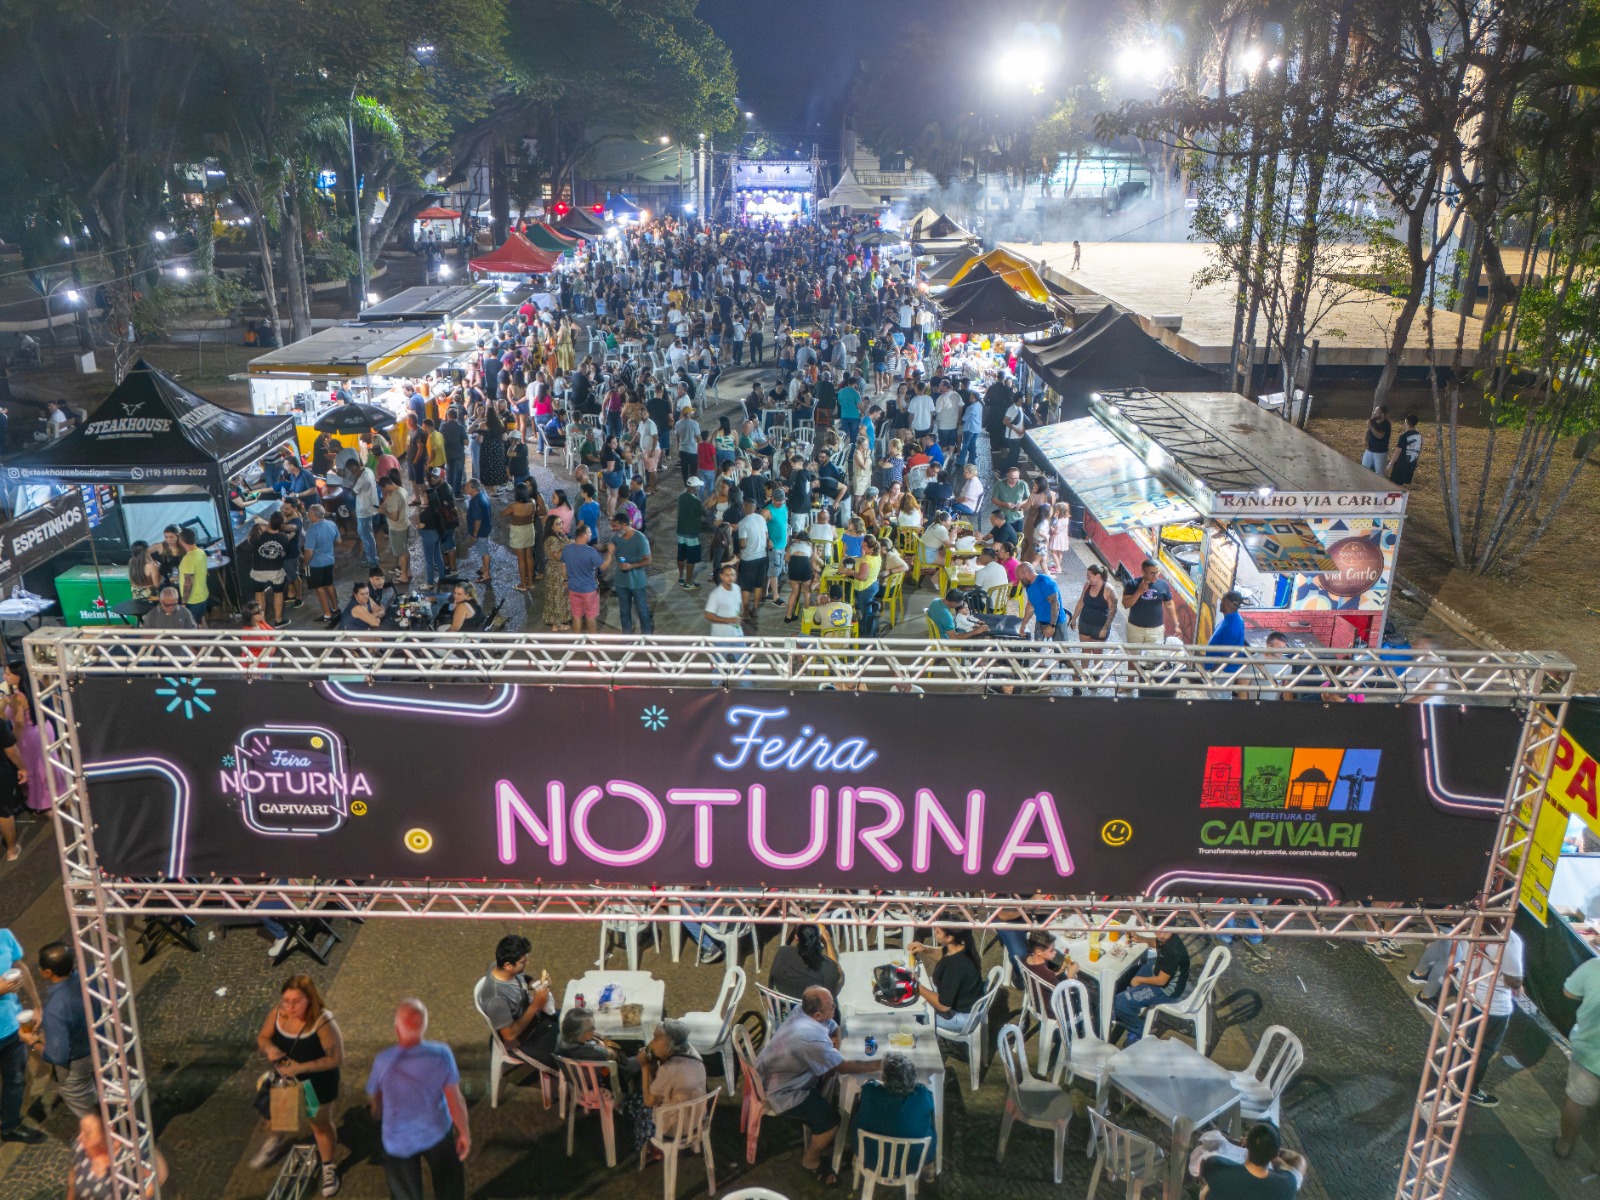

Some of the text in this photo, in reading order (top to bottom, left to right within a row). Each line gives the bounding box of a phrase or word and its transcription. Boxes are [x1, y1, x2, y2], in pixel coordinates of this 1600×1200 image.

[84, 417, 172, 435] STEAKHOUSE
[21, 468, 110, 478] @steakhouseboutique
[146, 468, 161, 478] (19)
[1223, 495, 1297, 507] RANCHO
[1304, 495, 1332, 506] VIA
[1338, 495, 1396, 507] CARLO
[12, 505, 82, 557] ESPETINHOS
[1346, 567, 1377, 581] Carlo
[80, 610, 127, 619] Heineke
[716, 704, 880, 772] Feira
[270, 749, 311, 768] Feira
[220, 769, 373, 796] NOTURNA
[259, 803, 330, 815] CAPIVARI
[1249, 812, 1317, 821] PREFEITURA DE
[494, 778, 1075, 877] NOTURNA
[1200, 820, 1363, 848] CAPIVARI
[1198, 847, 1250, 855] Transformando
